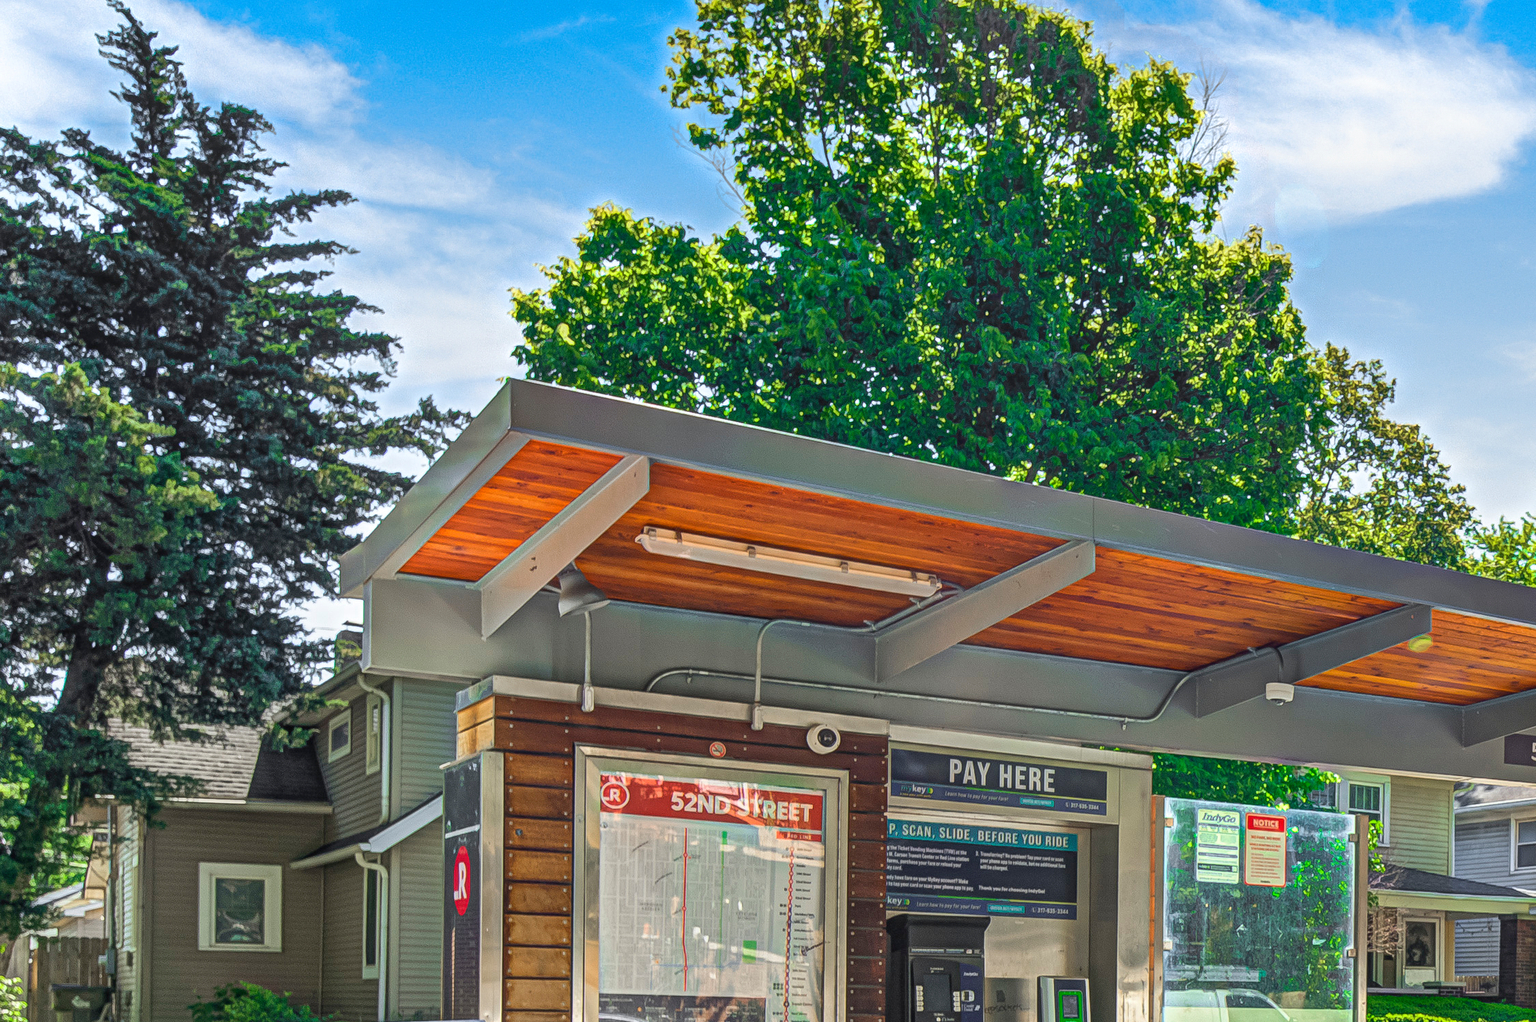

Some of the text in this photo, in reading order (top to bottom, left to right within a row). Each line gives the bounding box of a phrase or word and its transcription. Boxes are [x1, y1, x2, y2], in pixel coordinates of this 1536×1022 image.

[949, 758, 1056, 793] PAY HERE
[670, 791, 813, 823] 52ND STREET
[1202, 812, 1236, 823] IndyGo
[1253, 818, 1279, 828] NOTICE
[902, 824, 935, 838] SCAN,
[939, 827, 974, 842] SLIDE,
[977, 830, 1018, 844] BEFORE
[1022, 834, 1042, 846] YOU
[1045, 835, 1069, 848] RIDE
